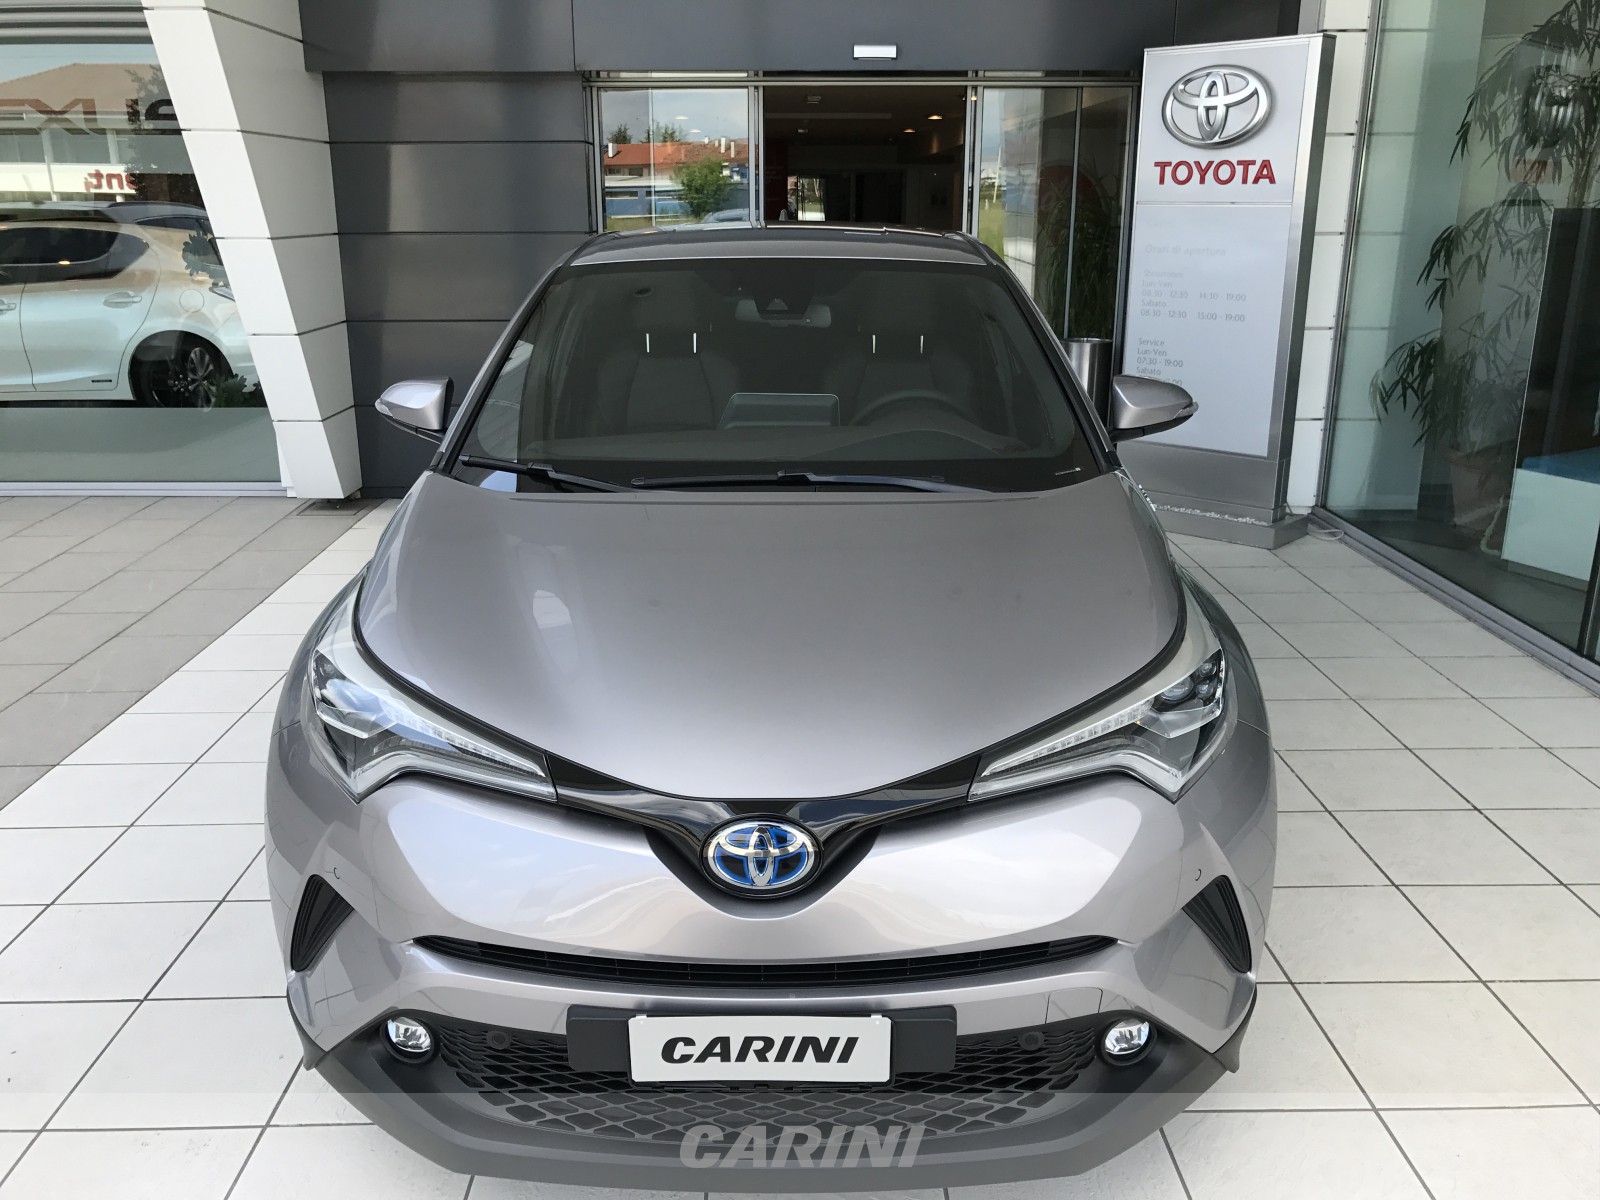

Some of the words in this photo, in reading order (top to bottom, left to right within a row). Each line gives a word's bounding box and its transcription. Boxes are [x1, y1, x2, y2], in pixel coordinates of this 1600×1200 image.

[1154, 160, 1276, 185] TOYOTA
[1172, 245, 1182, 255] di
[1184, 247, 1226, 257] apertura
[1141, 298, 1167, 307] Sabato
[1225, 313, 1246, 322] 19:00
[1138, 337, 1165, 346] Service
[1137, 347, 1167, 357] Lun-Ven
[661, 1035, 859, 1064] CARINI
